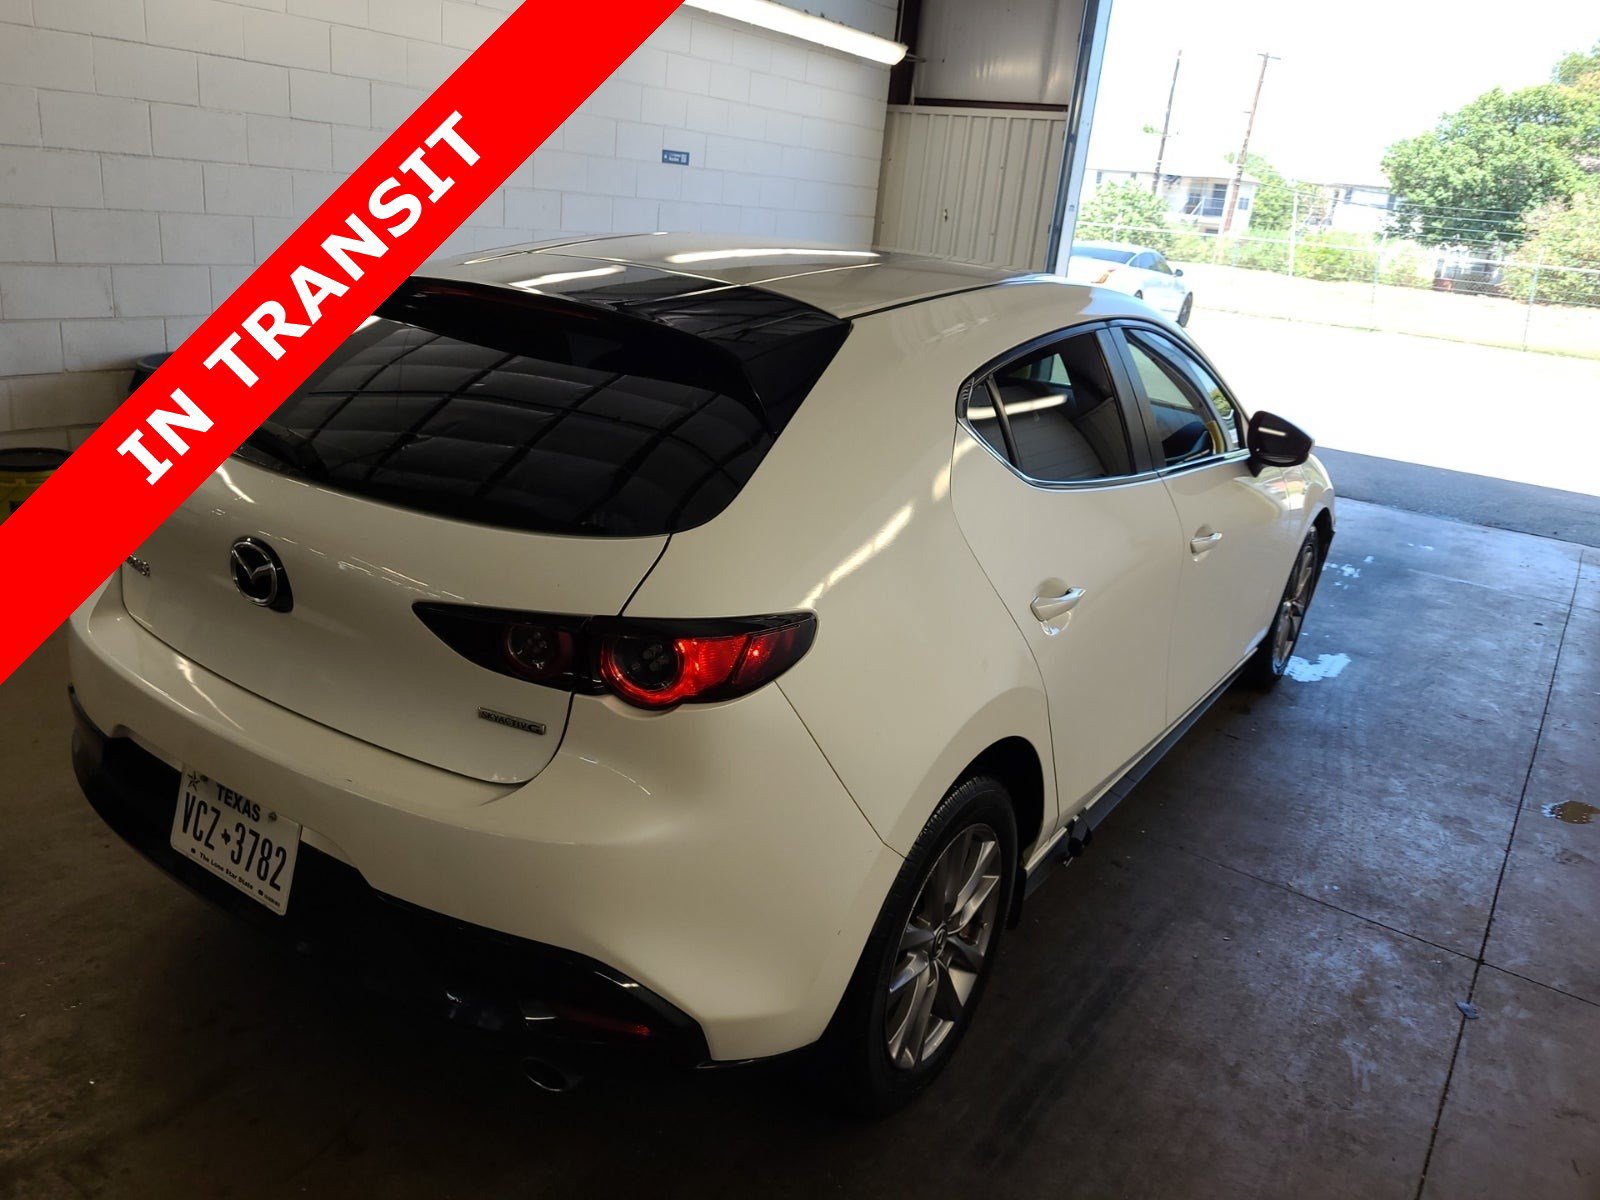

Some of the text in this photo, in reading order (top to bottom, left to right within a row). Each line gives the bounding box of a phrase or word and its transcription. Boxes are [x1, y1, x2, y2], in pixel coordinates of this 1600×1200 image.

[216, 783, 261, 822] TEXAS
[182, 791, 287, 892] VCZ 3782
[199, 851, 254, 890] The Lone Star State
